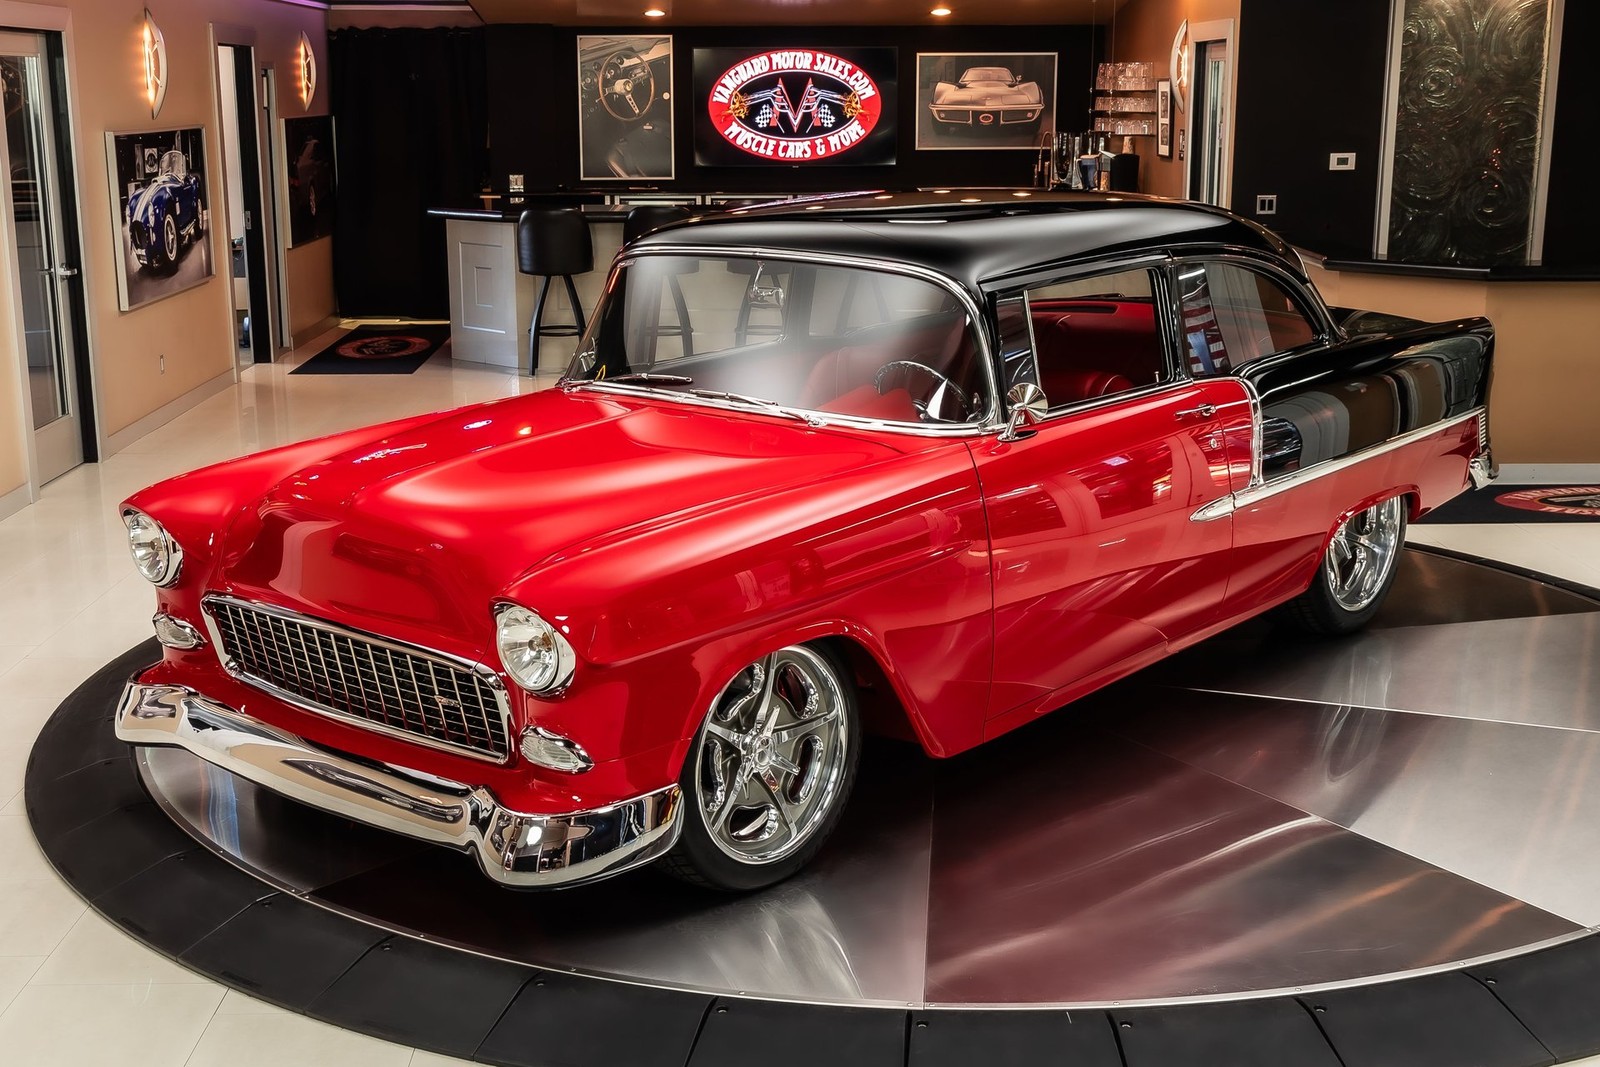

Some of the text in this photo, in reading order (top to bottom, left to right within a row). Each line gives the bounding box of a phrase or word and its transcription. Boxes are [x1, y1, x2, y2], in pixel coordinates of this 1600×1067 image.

[712, 55, 770, 103] VANGUARD
[770, 51, 812, 70] MOTOR
[723, 119, 866, 158] MUSCLE CARS & MORE
